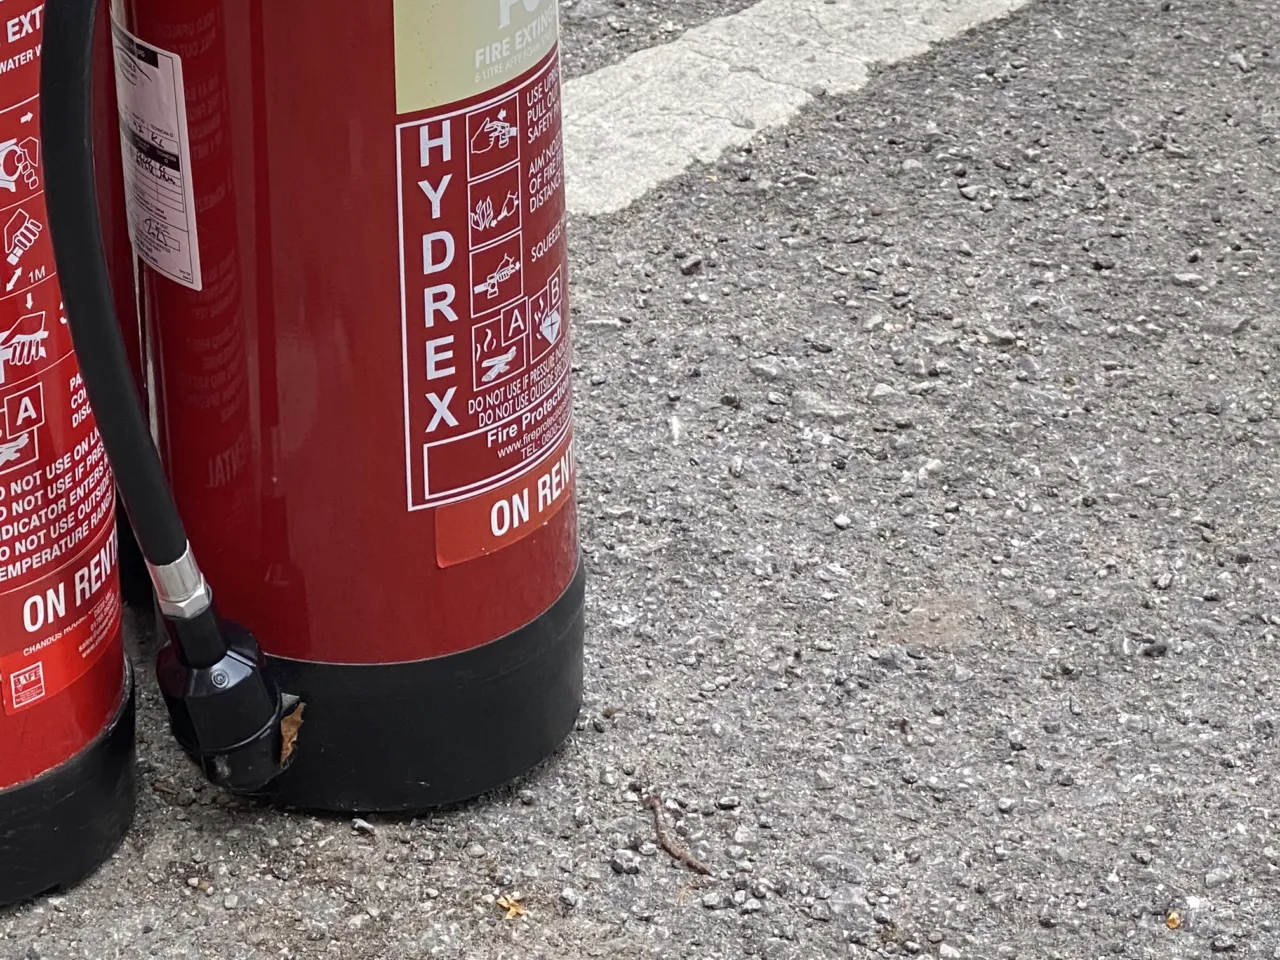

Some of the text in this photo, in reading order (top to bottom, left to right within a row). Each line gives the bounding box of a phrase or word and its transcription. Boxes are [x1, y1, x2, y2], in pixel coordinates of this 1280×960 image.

[475, 37, 510, 69] FIRE
[474, 72, 480, 84] 6
[483, 62, 504, 80] LITRE
[526, 82, 543, 107] USE
[527, 99, 546, 126] PULL
[528, 108, 553, 144] SAFETY
[529, 150, 545, 178] AIM
[529, 173, 542, 194] OF
[544, 157, 556, 183] FIRE
[28, 265, 47, 284] 1M
[549, 276, 560, 307] B
[508, 308, 524, 337] A
[468, 396, 483, 415] DO
[486, 386, 505, 409] NOT
[506, 378, 521, 398] USE
[523, 372, 529, 390] IF
[530, 352, 555, 385] PRESSURE
[16, 396, 37, 426] A
[479, 409, 493, 428] DO
[496, 399, 514, 421] NOT
[515, 391, 529, 411] USE
[530, 372, 554, 401] OUTSIDE
[488, 423, 518, 448] Fire
[520, 440, 540, 459] TEL:
[10, 470, 42, 498] NOT
[46, 452, 72, 480] USE
[74, 437, 89, 461] ON
[69, 461, 104, 506] ENTERS
[12, 489, 44, 517] NOT
[48, 472, 74, 500] USE
[75, 462, 85, 481] IF
[15, 530, 47, 557] NOT
[50, 512, 76, 539] USE
[77, 470, 110, 520] OUTSIDE
[490, 487, 529, 537] ON
[23, 582, 66, 633] ON
